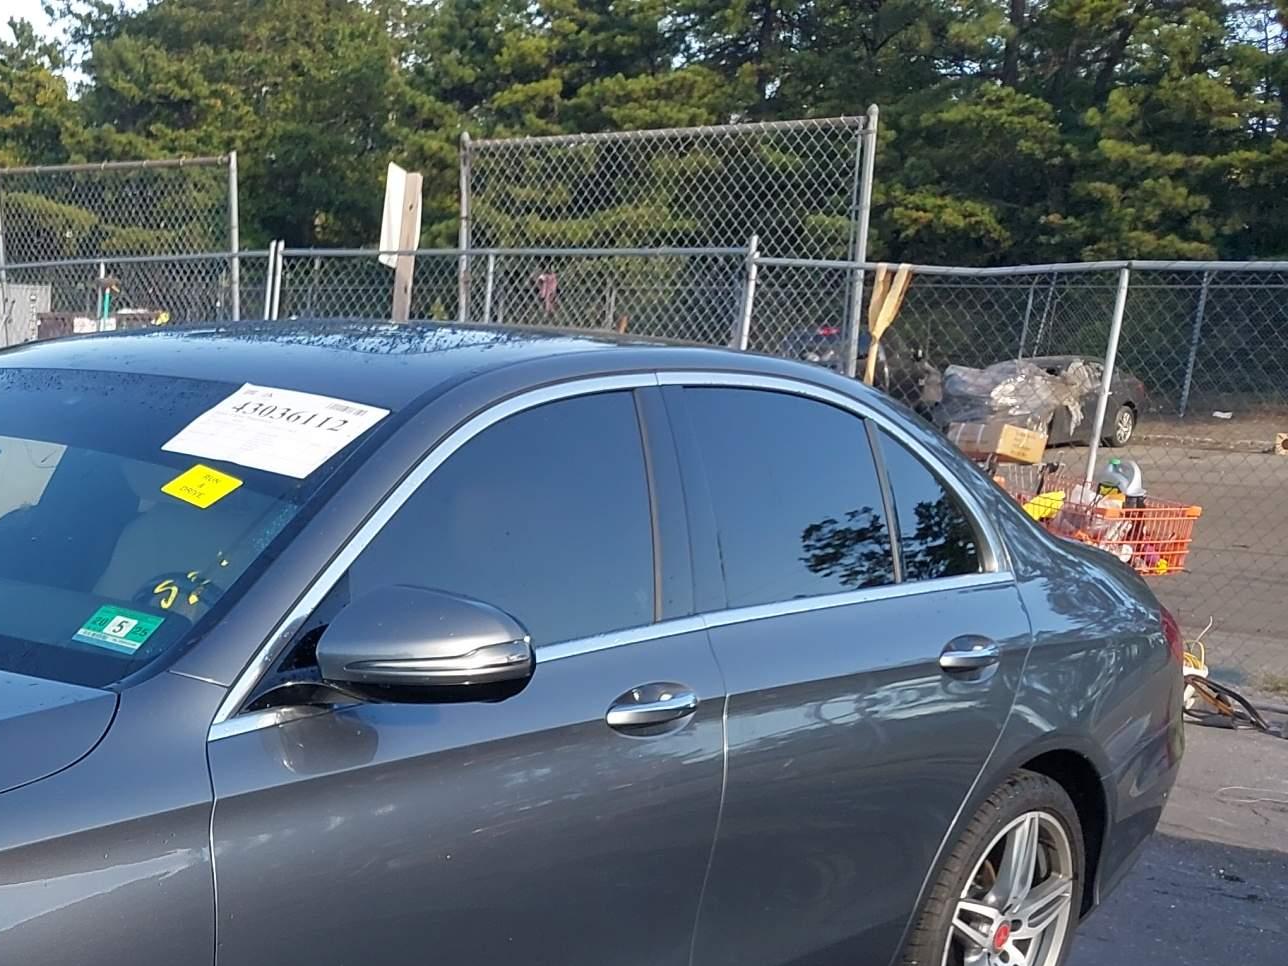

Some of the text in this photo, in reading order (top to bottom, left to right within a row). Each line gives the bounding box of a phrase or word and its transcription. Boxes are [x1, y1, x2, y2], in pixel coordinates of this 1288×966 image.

[231, 400, 349, 432] 43036112
[112, 620, 128, 633] 5
[133, 626, 148, 637] 25
